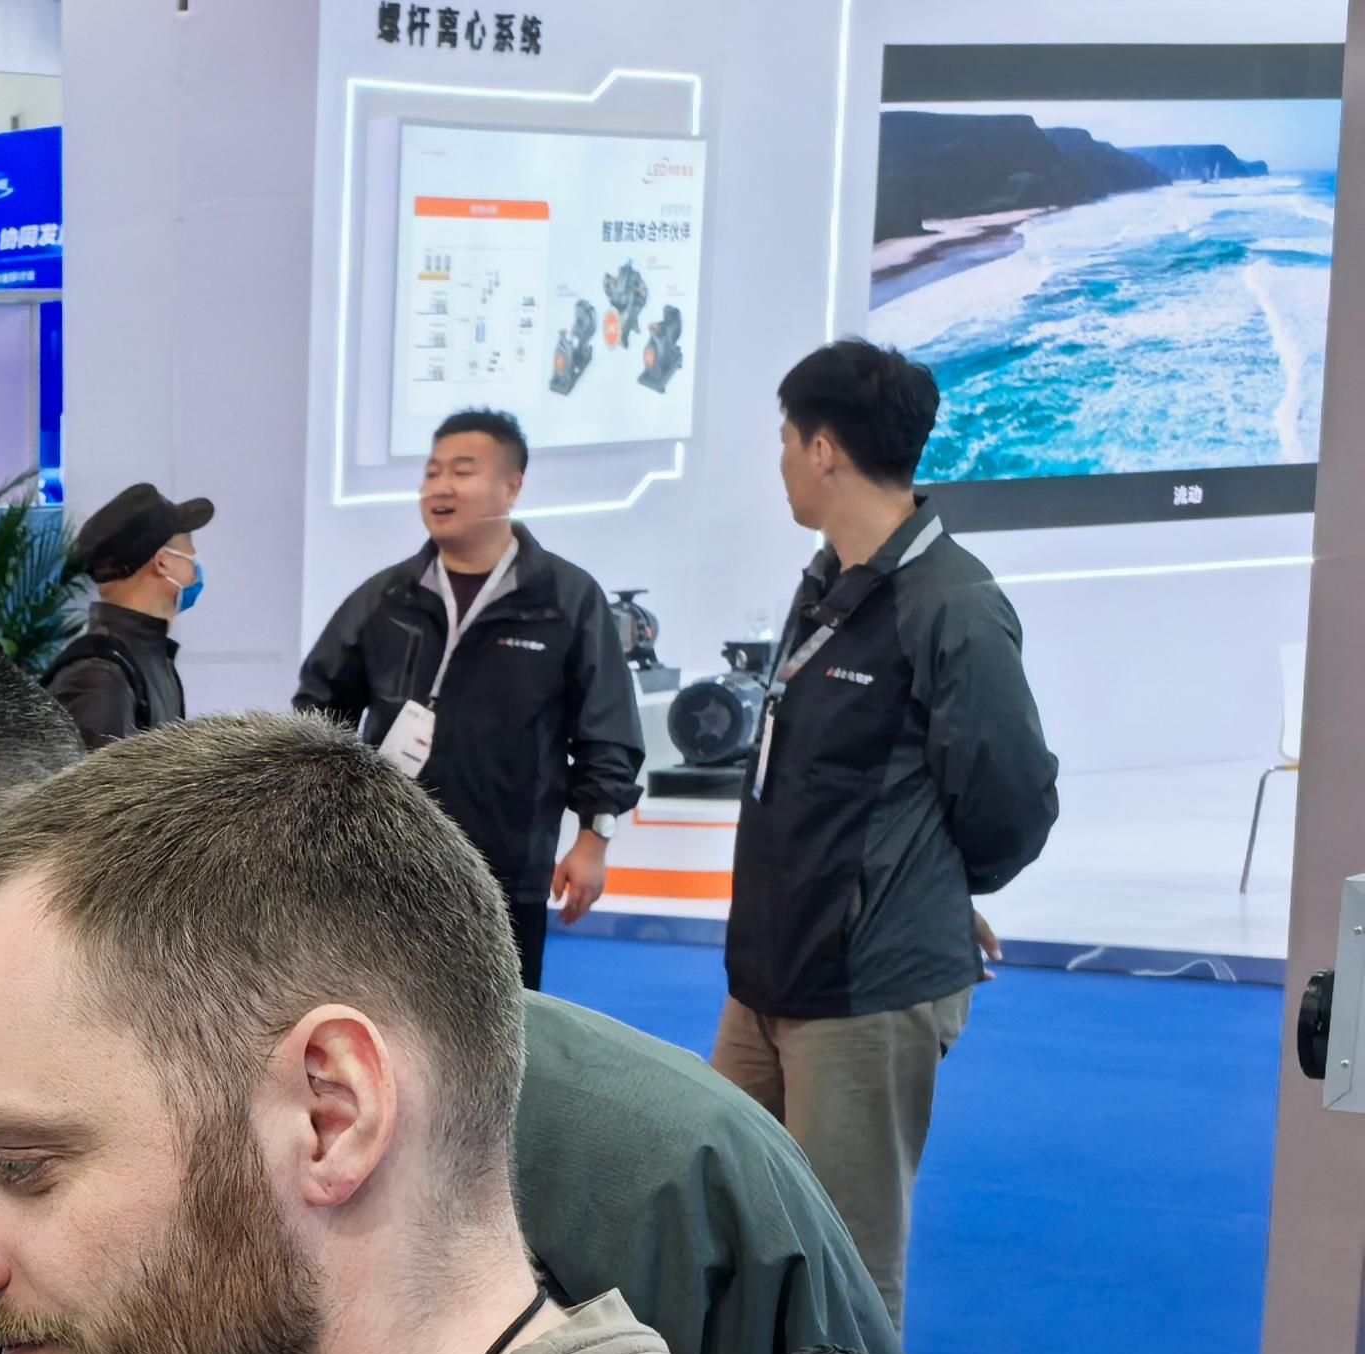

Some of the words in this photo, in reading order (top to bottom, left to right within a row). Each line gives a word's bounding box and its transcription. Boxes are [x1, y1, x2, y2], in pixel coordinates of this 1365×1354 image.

[377, 0, 542, 55] 螺杆离心系统
